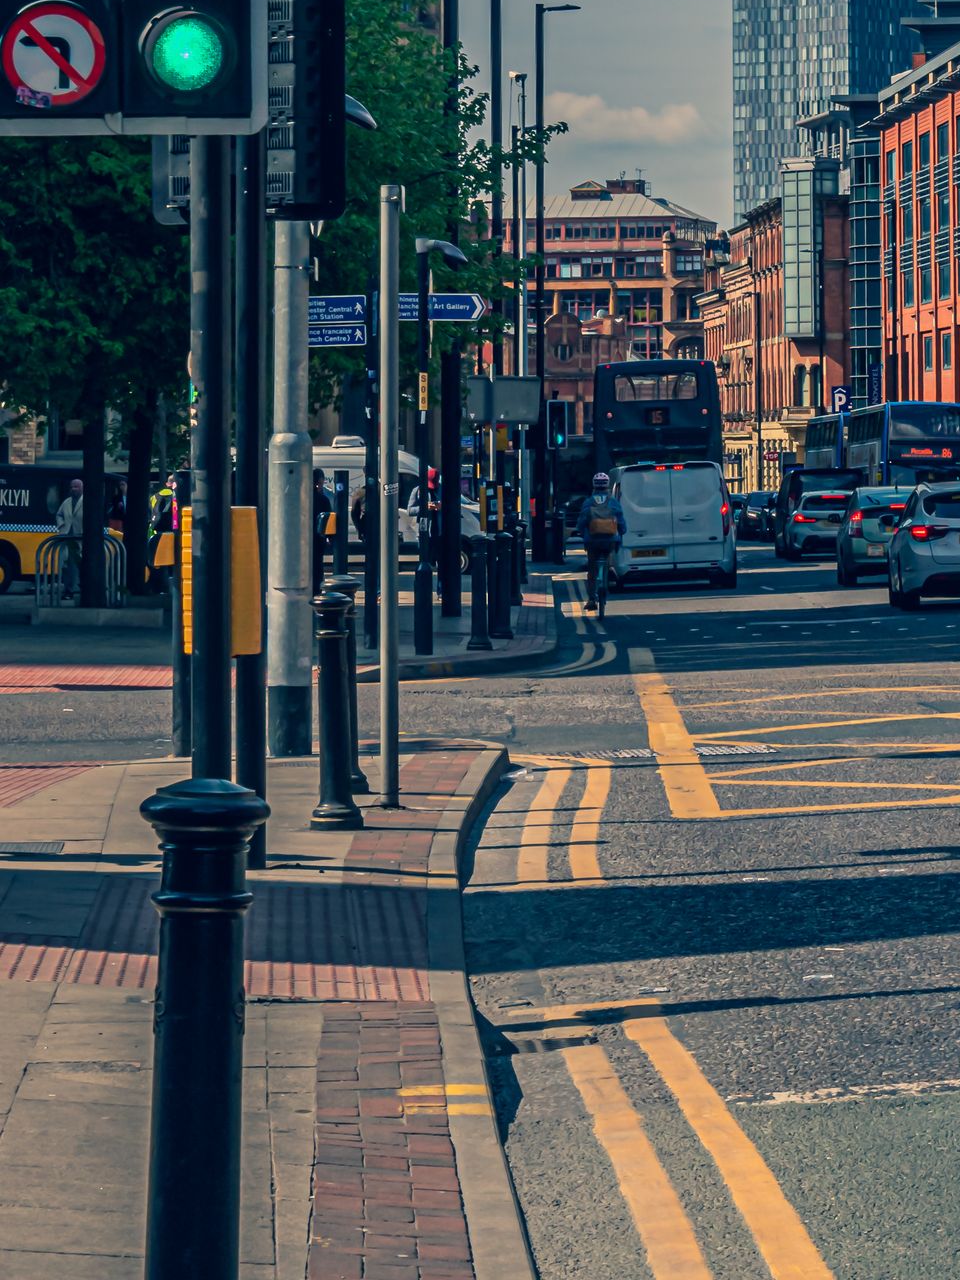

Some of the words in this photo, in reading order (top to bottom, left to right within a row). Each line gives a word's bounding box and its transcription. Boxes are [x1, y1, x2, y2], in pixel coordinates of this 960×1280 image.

[446, 303, 470, 311] Gallery
[871, 366, 879, 405] NOVOTEL
[941, 448, 953, 459] 86
